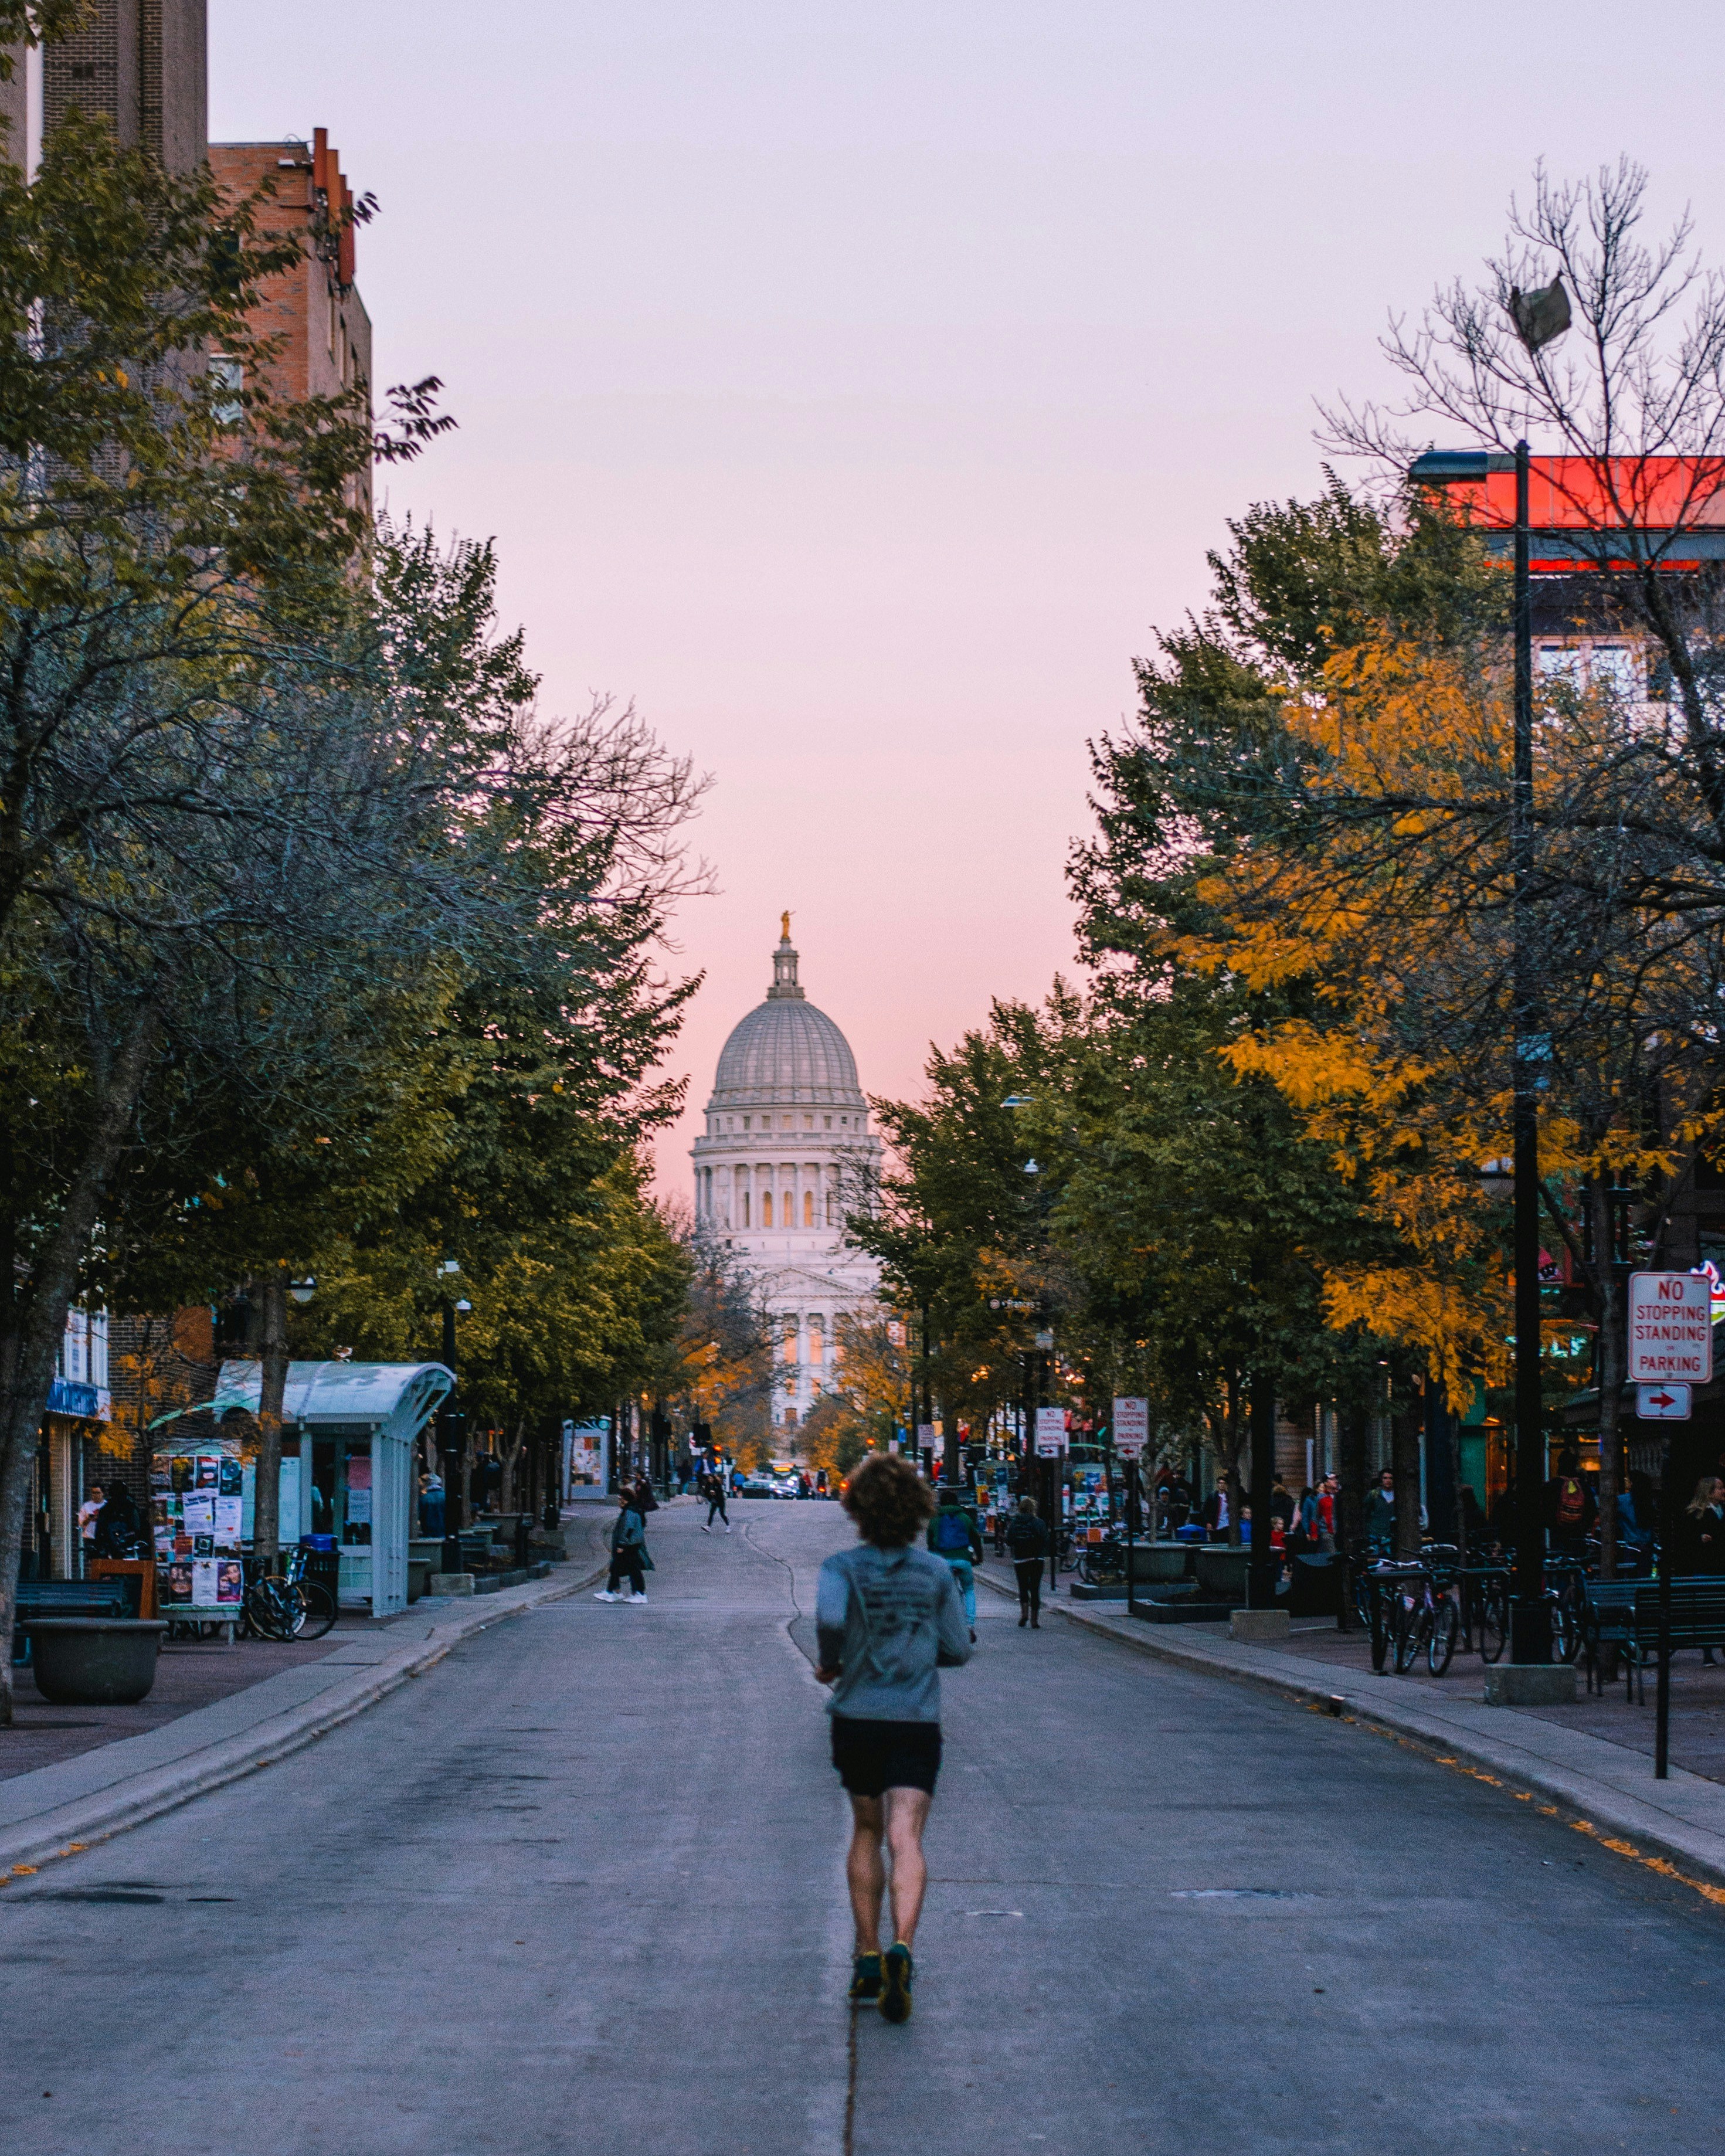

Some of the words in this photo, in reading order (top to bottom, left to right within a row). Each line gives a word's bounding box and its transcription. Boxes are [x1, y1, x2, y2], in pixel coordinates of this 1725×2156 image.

[1658, 1281, 1684, 1301] NO
[1636, 1305, 1706, 1321] STOPPING
[1635, 1325, 1706, 1341] STANDING
[1640, 1356, 1700, 1371] PARKING
[1125, 1401, 1136, 1410] NO
